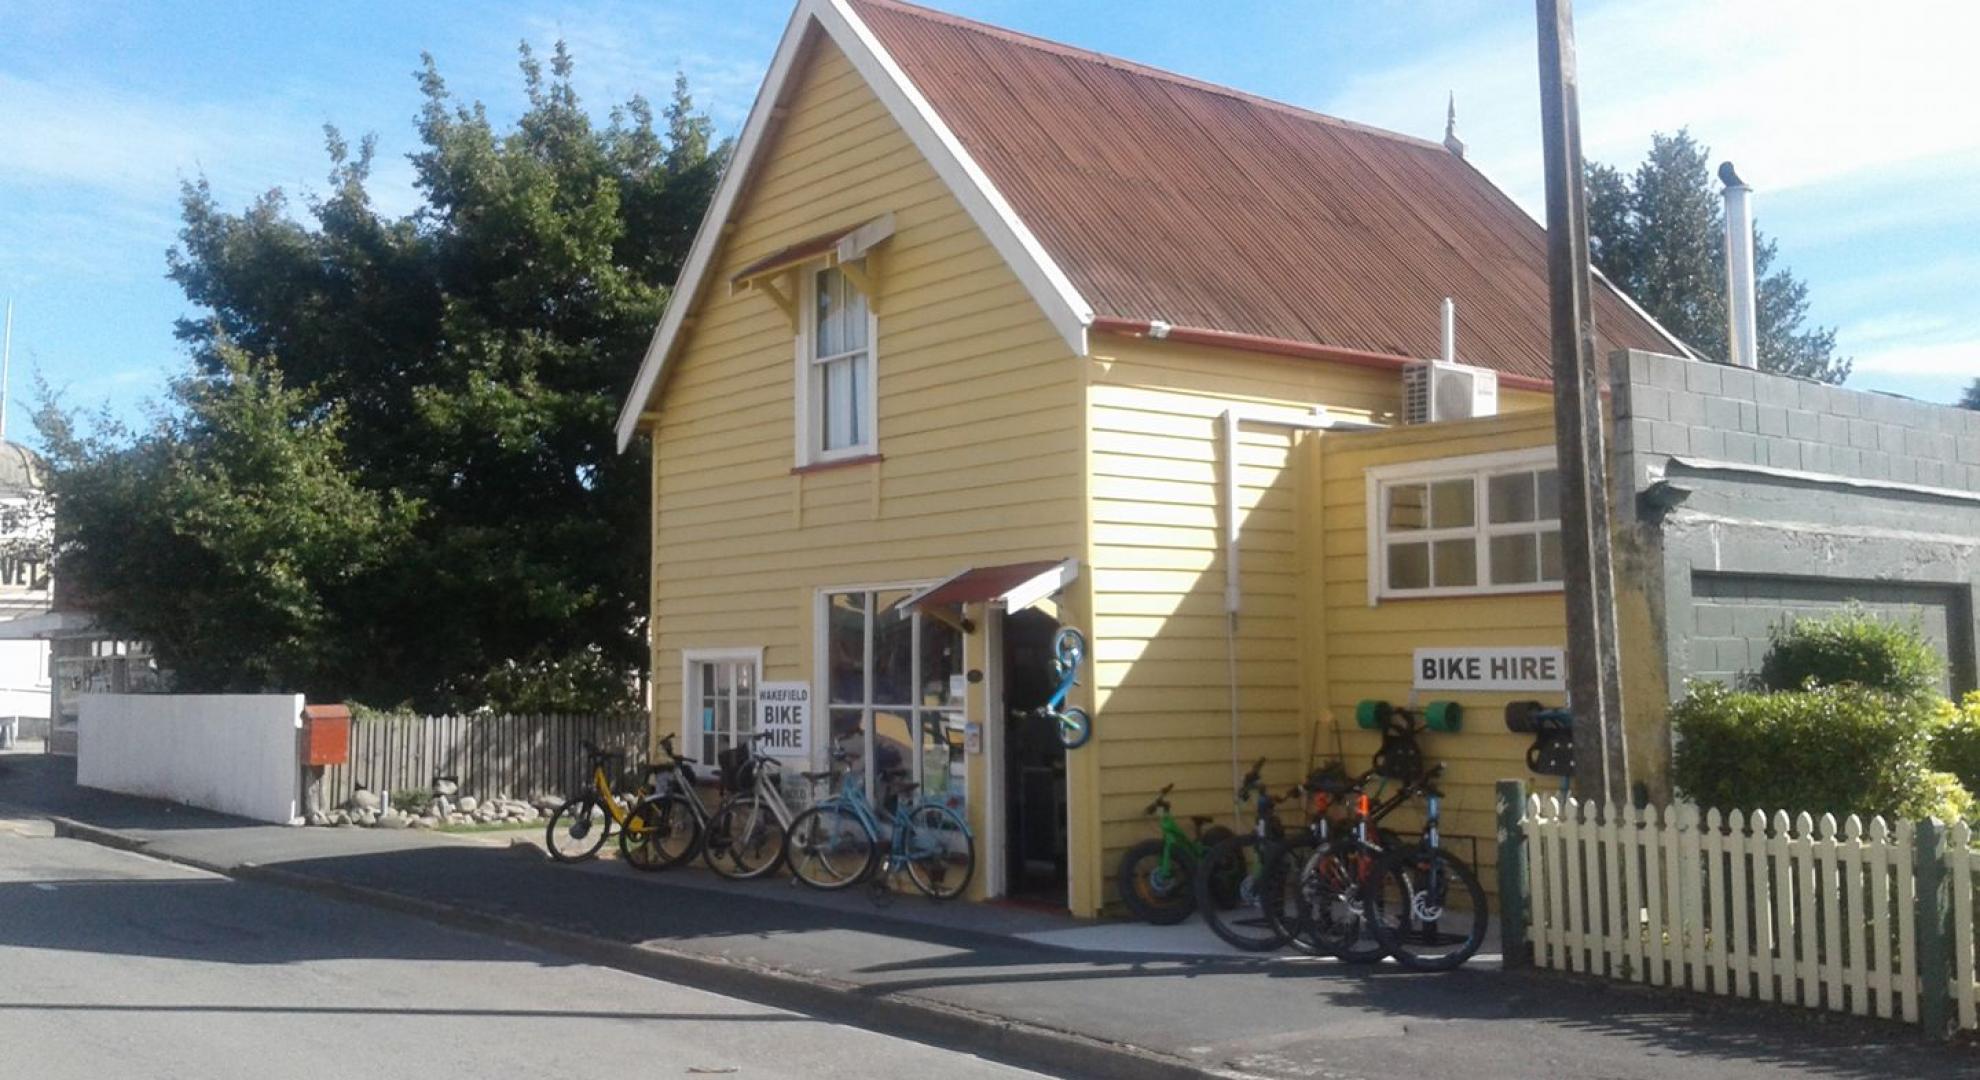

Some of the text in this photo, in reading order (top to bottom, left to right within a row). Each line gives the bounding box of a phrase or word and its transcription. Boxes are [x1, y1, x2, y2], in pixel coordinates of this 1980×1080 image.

[1422, 656, 1557, 680] BIKE HIRE
[760, 688, 808, 701] WAKEFIELD
[764, 705, 802, 724] BIKE
[764, 728, 802, 747] HIRE
